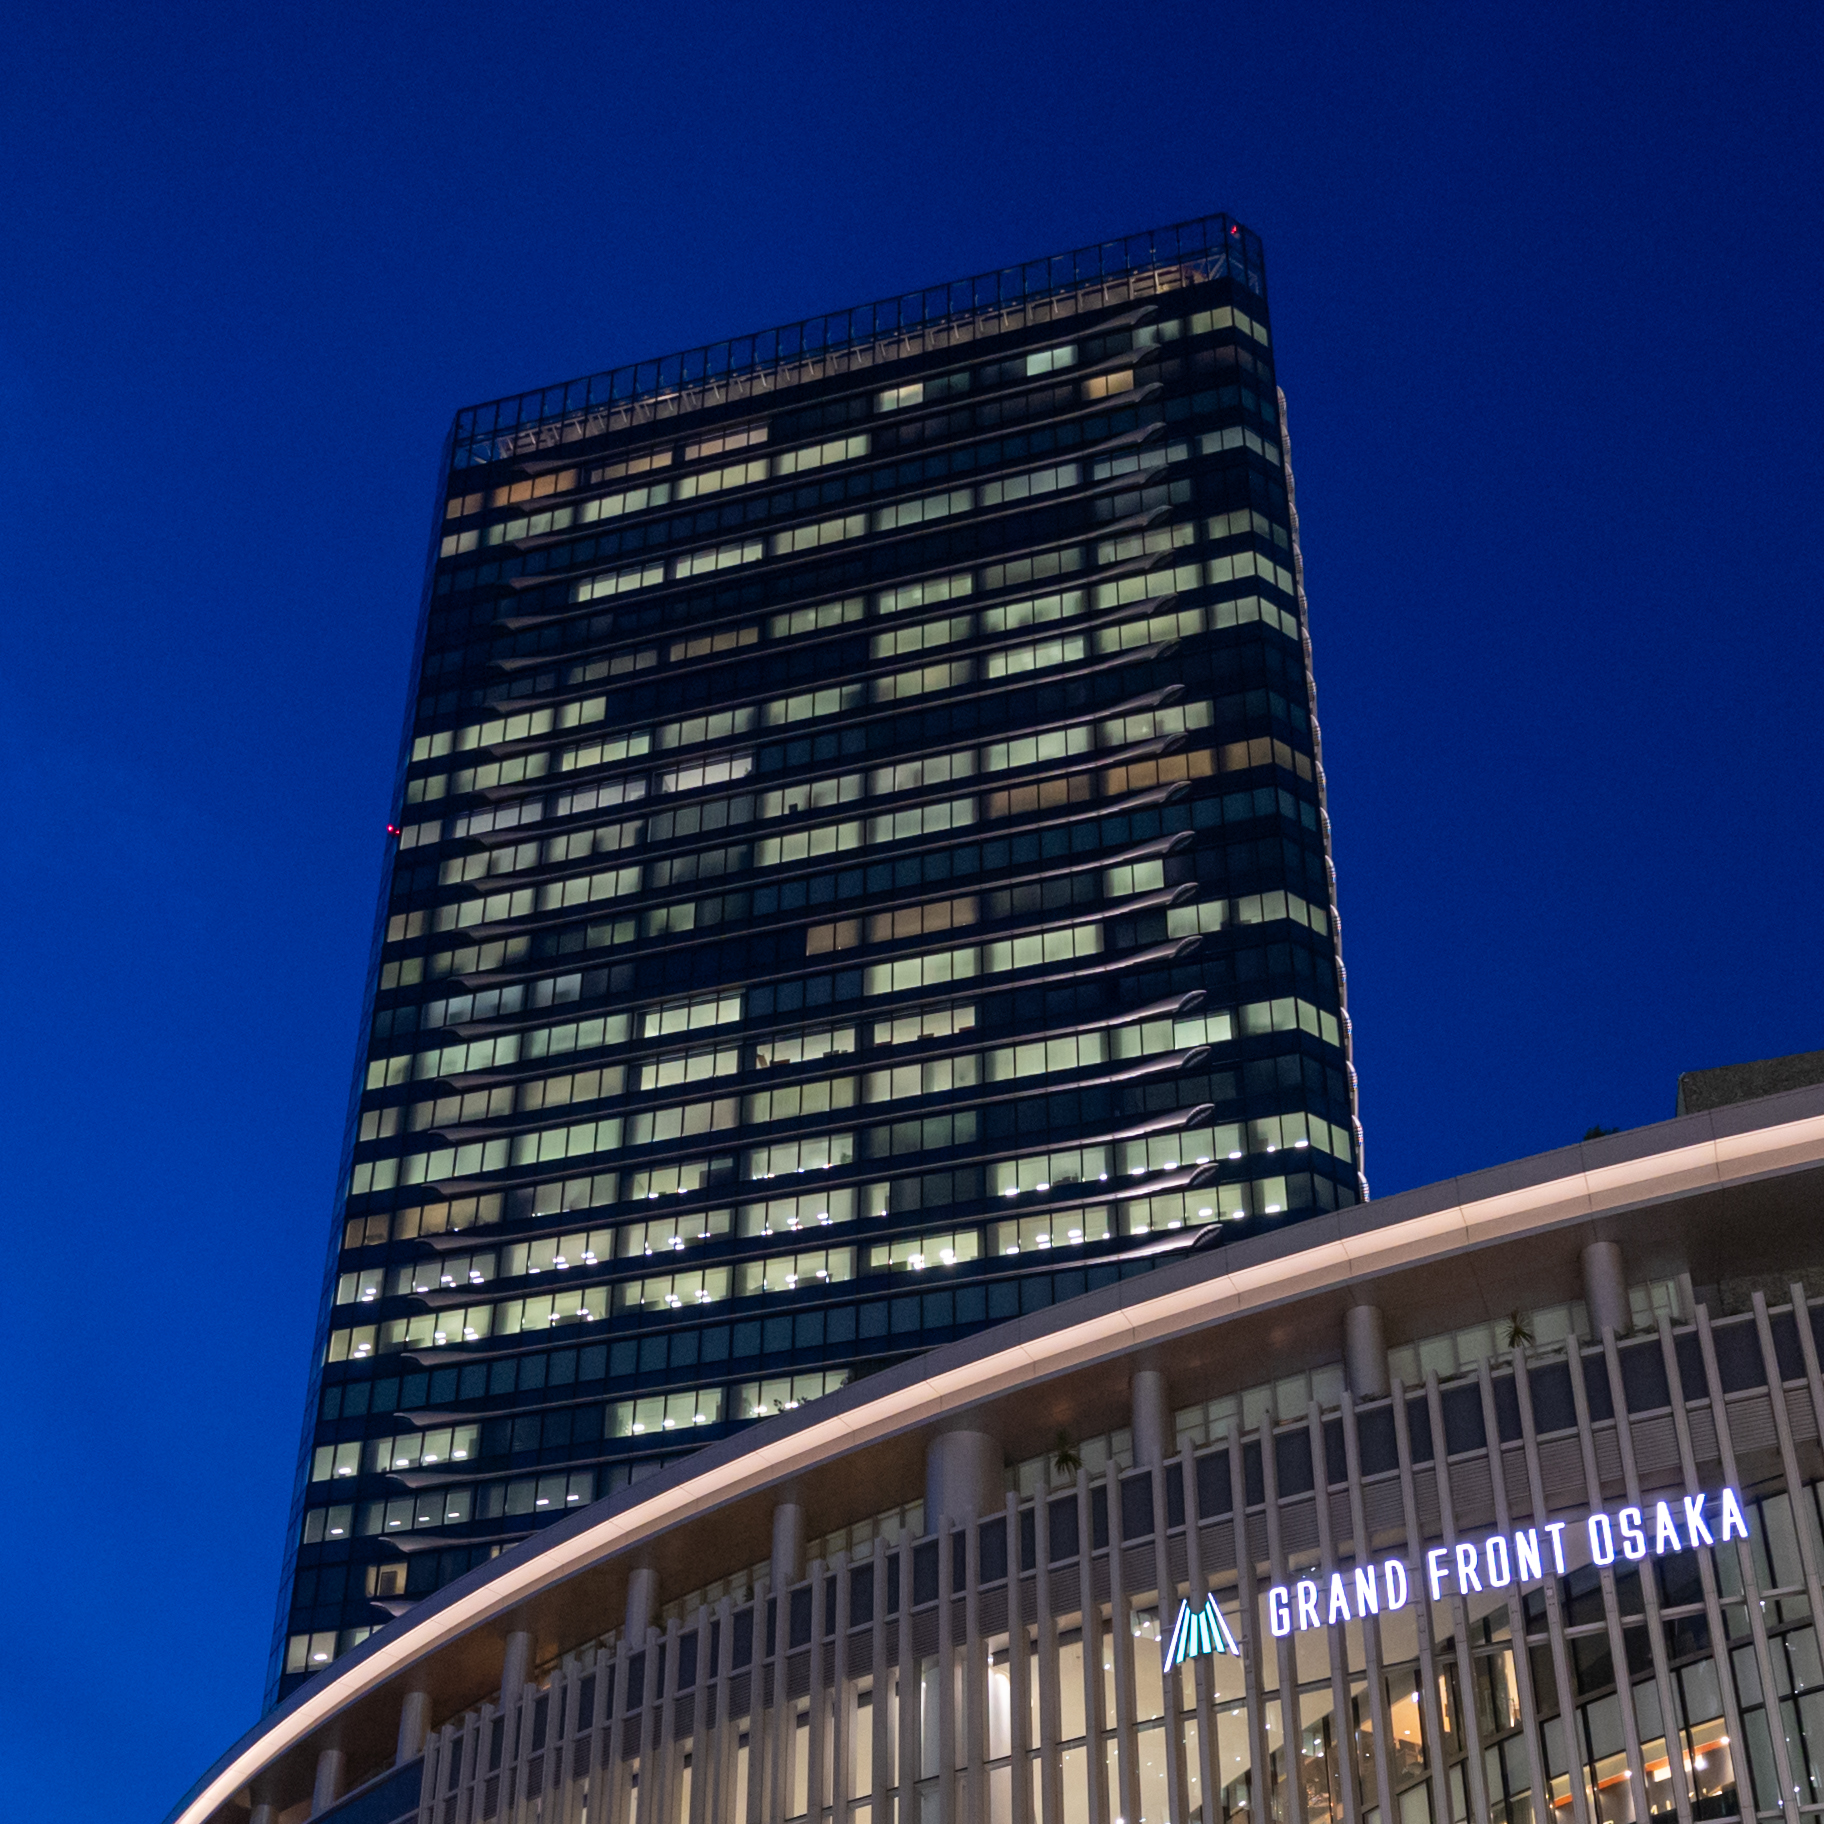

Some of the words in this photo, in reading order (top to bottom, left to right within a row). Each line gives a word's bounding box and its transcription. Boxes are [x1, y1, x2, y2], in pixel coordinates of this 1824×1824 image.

[1266, 1557, 1409, 1638] GRAND
[1426, 1521, 1567, 1601] FRONT
[1587, 1486, 1751, 1567] OSAKA
